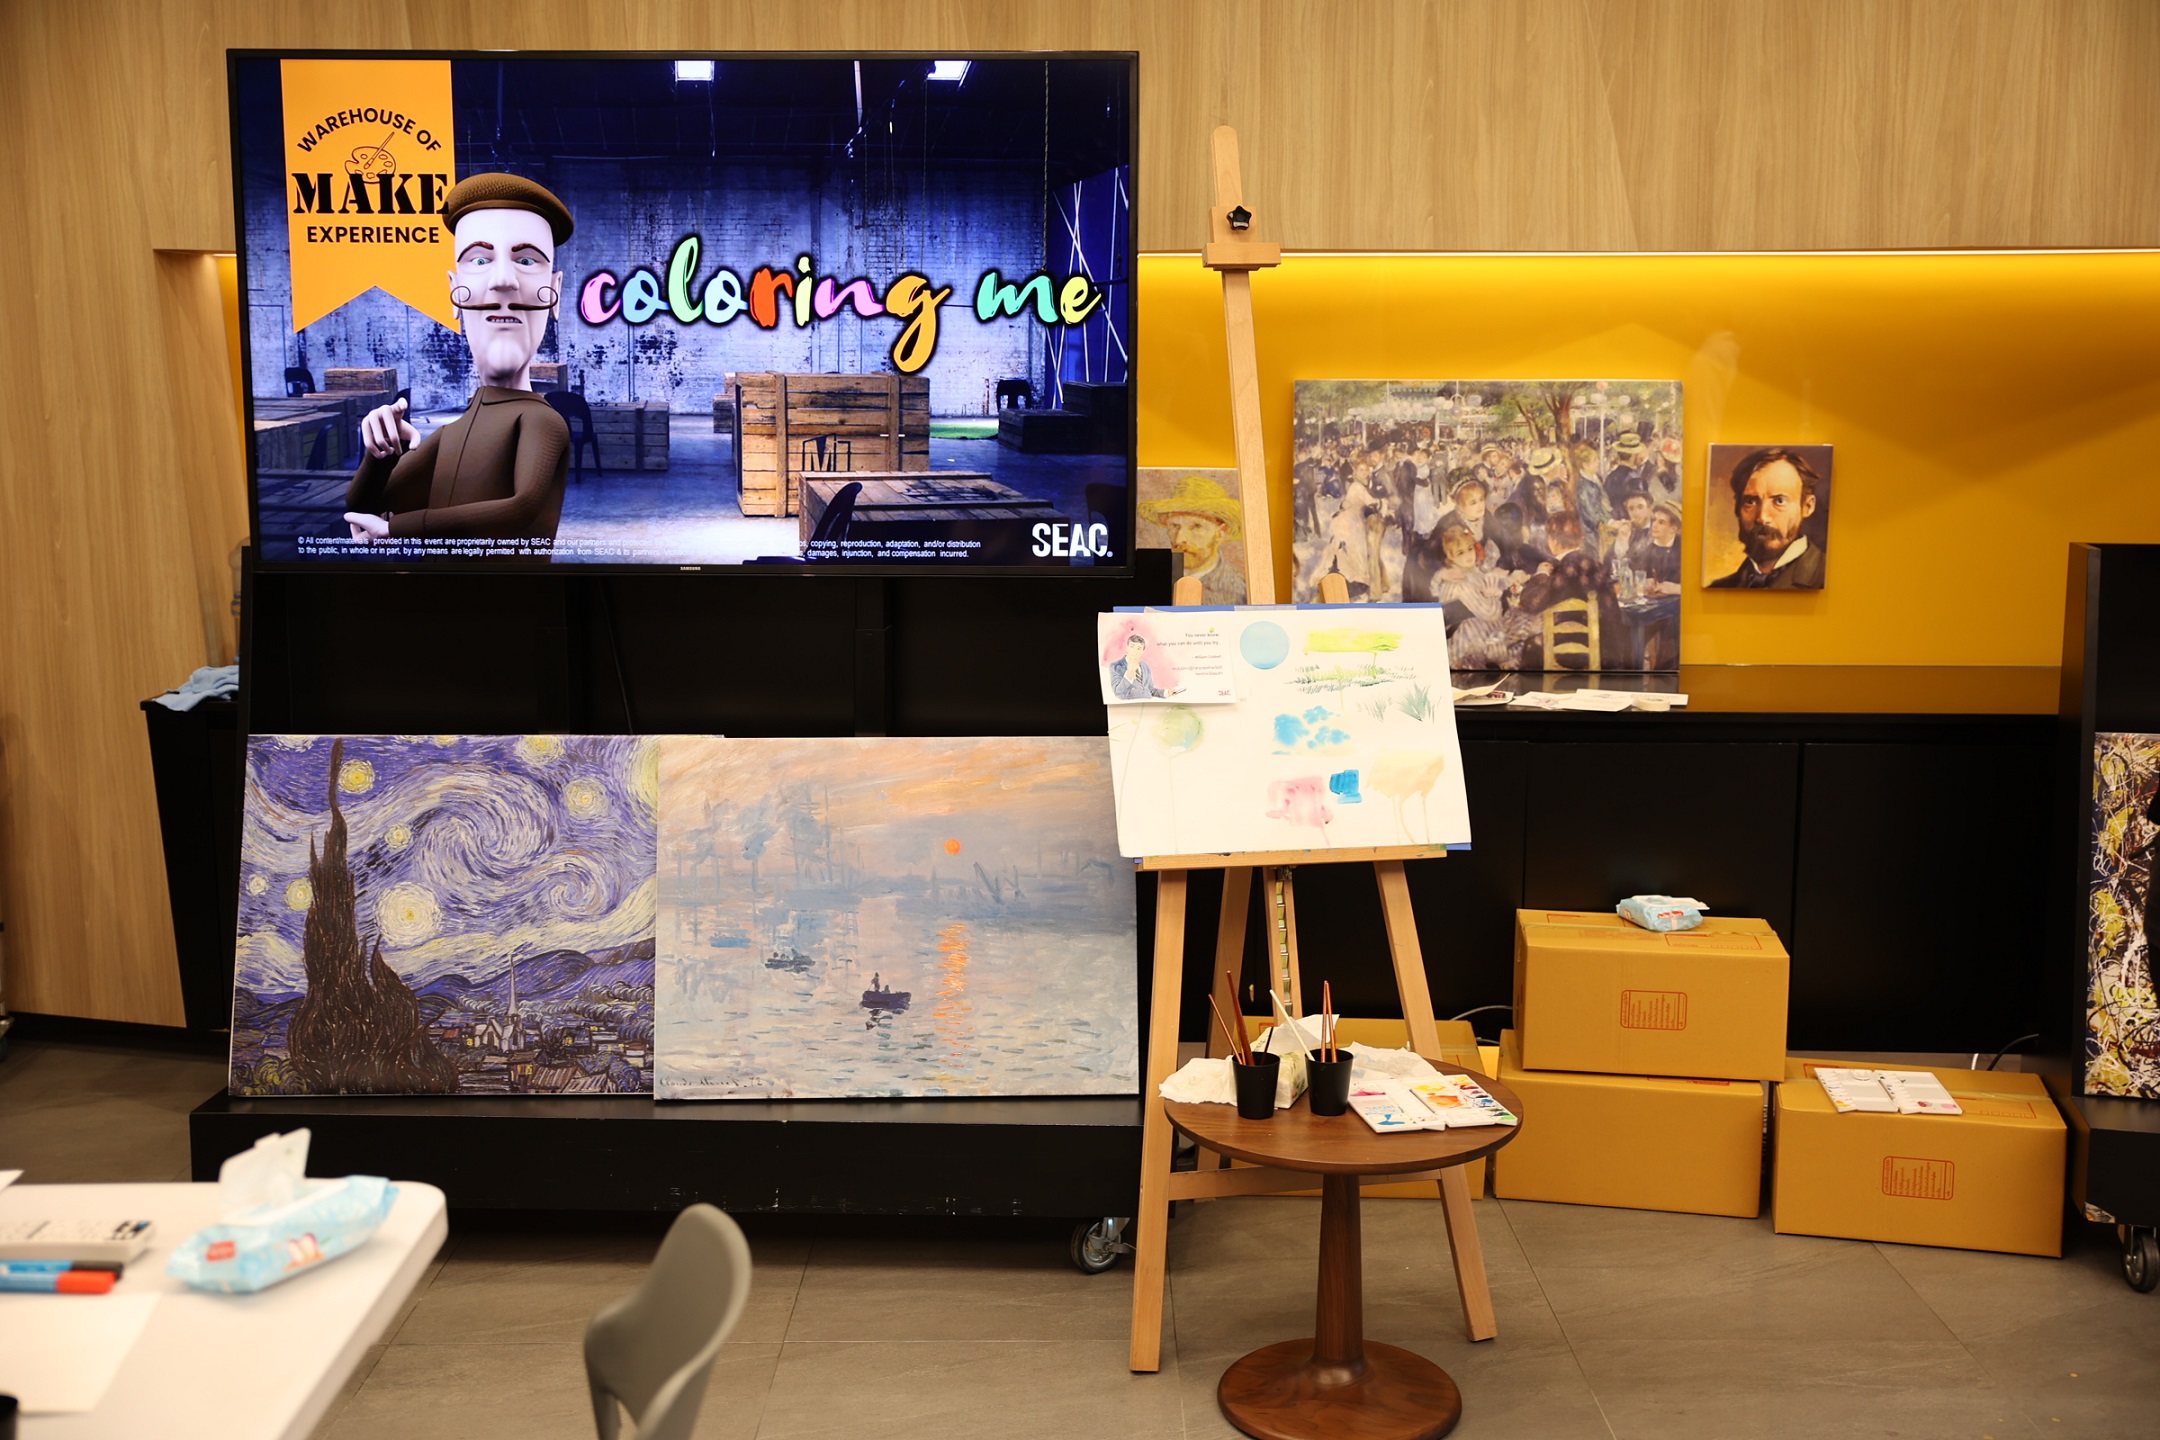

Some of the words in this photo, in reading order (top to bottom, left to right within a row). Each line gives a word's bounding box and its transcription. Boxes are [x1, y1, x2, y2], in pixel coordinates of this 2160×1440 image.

[297, 107, 416, 152] WAREHOUSE
[416, 129, 442, 151] OF
[291, 173, 449, 215] MAKE
[307, 226, 440, 244] EXPERIENCE
[580, 236, 950, 373] coloring
[977, 271, 1102, 326] me
[373, 537, 402, 547] provided
[403, 537, 410, 545] in
[411, 537, 422, 545] this
[424, 538, 443, 546] event
[497, 538, 519, 546] owned
[520, 538, 529, 547] by
[531, 538, 551, 546] SEAC
[553, 538, 565, 546] and
[579, 539, 606, 548] partners
[810, 540, 838, 549] copying,
[841, 540, 883, 549] reproduction,
[885, 540, 921, 549] adaptation,
[923, 540, 945, 548] and/or
[947, 540, 981, 548] distribution
[298, 546, 305, 554] to
[306, 546, 316, 554] the
[318, 546, 339, 555] public,
[341, 546, 348, 554] in
[349, 546, 369, 554] whole
[379, 546, 385, 554] in
[386, 547, 401, 556] part,
[403, 547, 412, 556] by
[413, 549, 426, 557] any
[463, 547, 484, 557] legally
[486, 547, 515, 556] permitted
[534, 548, 574, 556] authorization
[594, 548, 615, 556] SEAC
[807, 549, 839, 559] damages,
[841, 549, 873, 559] injunction,
[891, 550, 936, 559] compensation
[939, 550, 970, 558] incurred.
